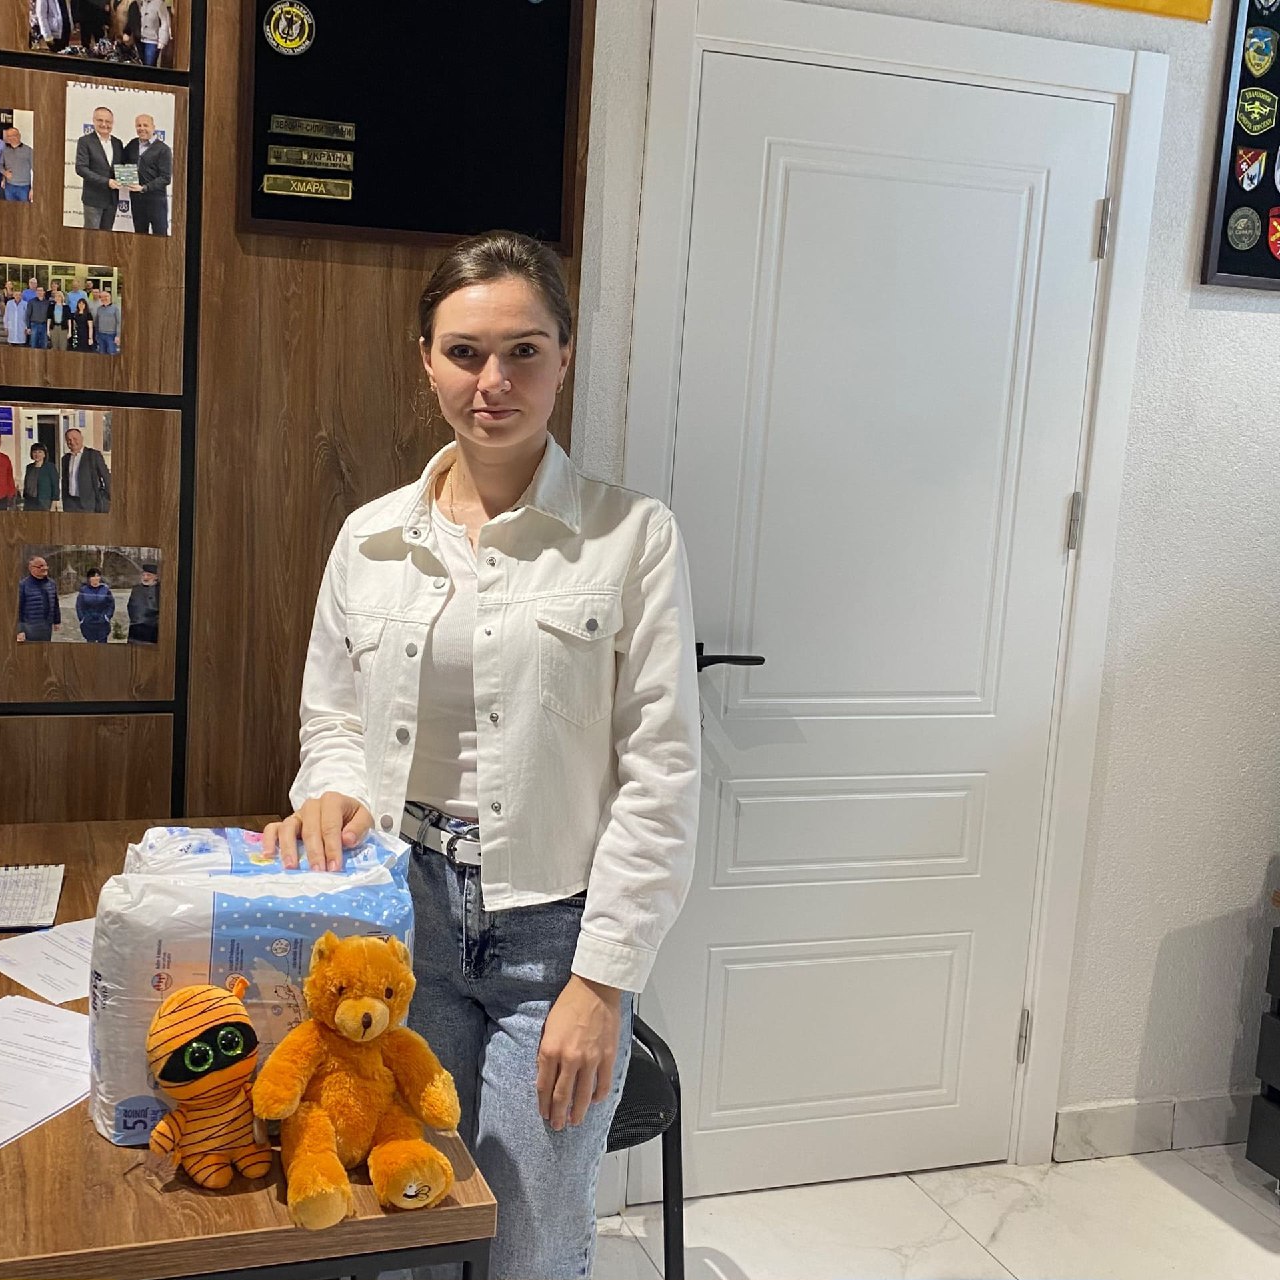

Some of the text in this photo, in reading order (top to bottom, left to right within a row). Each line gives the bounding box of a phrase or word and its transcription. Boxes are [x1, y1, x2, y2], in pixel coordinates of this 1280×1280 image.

[308, 151, 348, 162] УКРАЇНА
[290, 180, 326, 194] ХМАРА
[122, 1118, 148, 1131] 5
